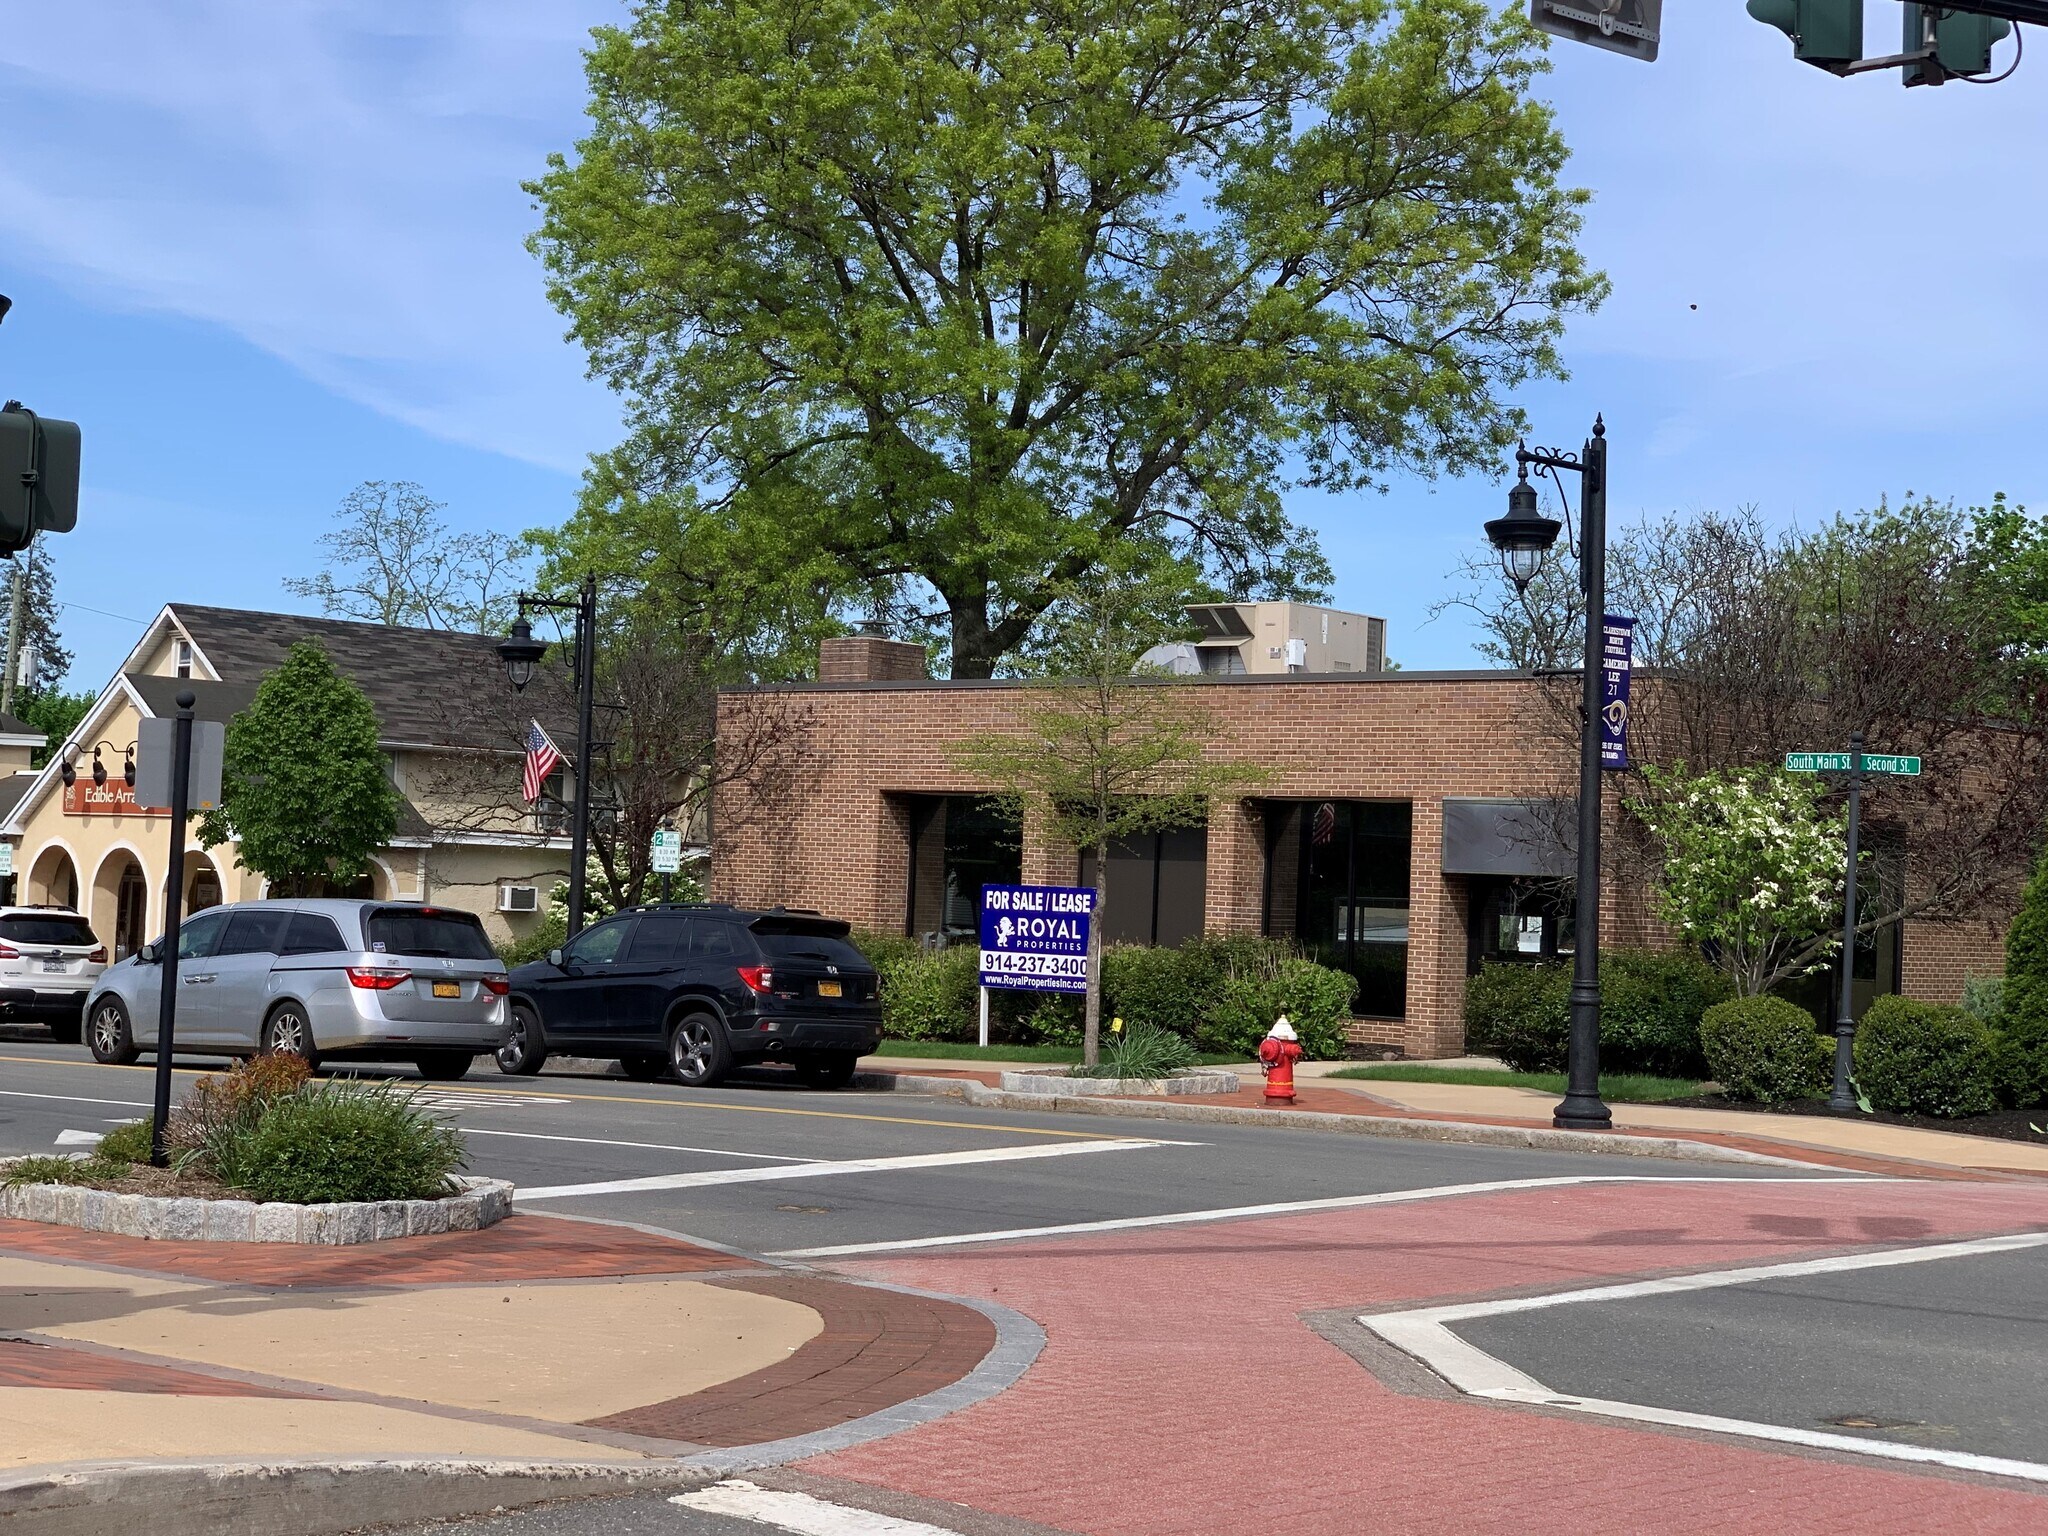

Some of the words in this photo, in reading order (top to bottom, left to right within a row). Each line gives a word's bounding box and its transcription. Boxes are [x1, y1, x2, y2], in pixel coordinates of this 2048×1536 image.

[1608, 671, 1620, 682] LEE
[1607, 684, 1618, 696] 21
[1788, 755, 1813, 769] South
[1817, 754, 1838, 769] Main
[1866, 757, 1897, 772] Second
[1899, 759, 1910, 772] St.
[85, 782, 114, 803] Edible
[656, 833, 663, 845] 2
[985, 890, 1010, 910] FOR
[1012, 891, 1043, 911] SALE
[1052, 893, 1091, 913] LEASE
[1017, 917, 1082, 939] ROYAL
[1016, 940, 1082, 951] PROPERTIES
[985, 953, 1087, 975] 914-237-3400
